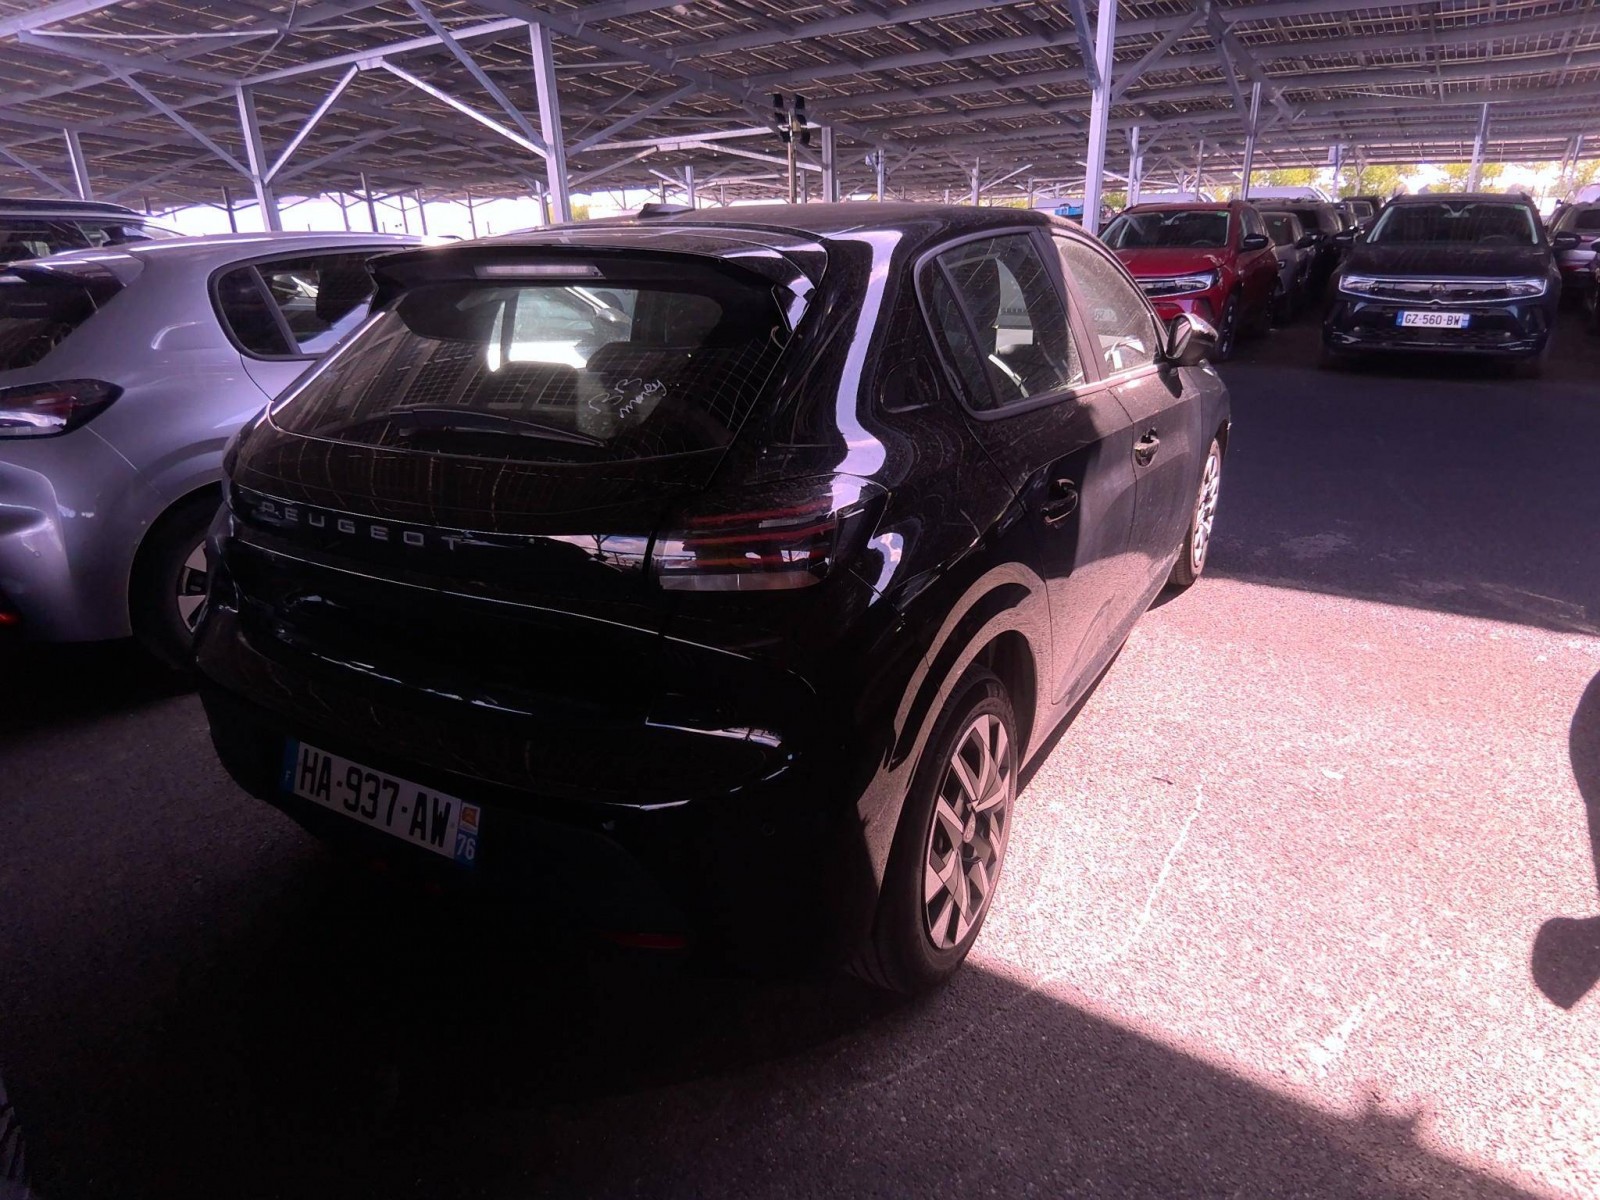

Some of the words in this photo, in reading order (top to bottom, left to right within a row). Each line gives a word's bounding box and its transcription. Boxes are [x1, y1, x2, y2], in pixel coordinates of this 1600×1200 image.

[1405, 314, 1461, 326] GZ-560-BW
[258, 501, 463, 552] PEUGEOT
[300, 748, 452, 849] HA-937-AW
[456, 834, 476, 861] 76
